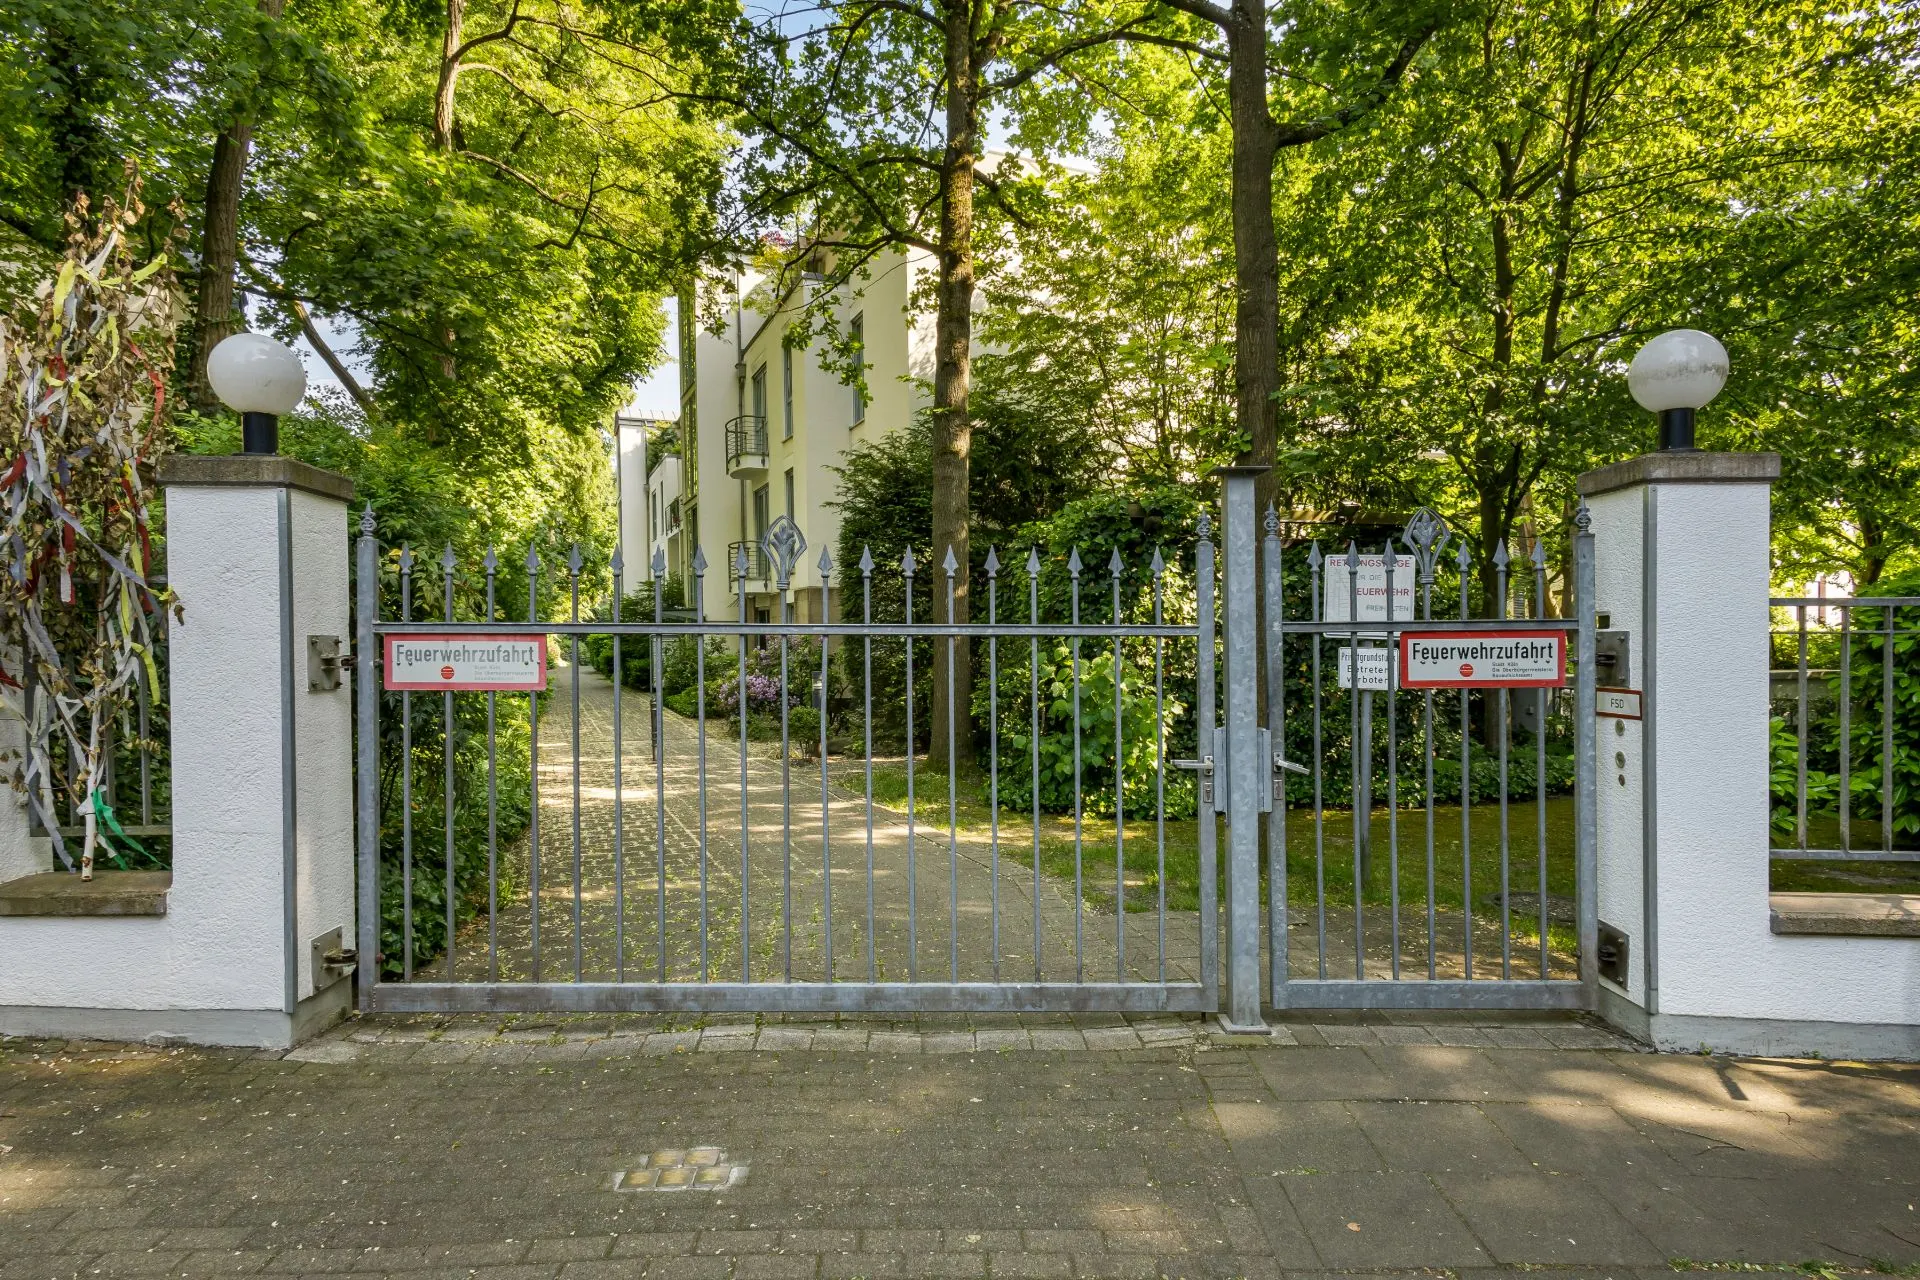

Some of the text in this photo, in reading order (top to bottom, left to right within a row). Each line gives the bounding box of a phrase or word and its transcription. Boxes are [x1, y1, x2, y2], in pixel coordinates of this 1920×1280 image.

[396, 644, 535, 663] Feuerwehrzufahrt
[1412, 642, 1554, 660] Feuerwehrzufahrt
[1610, 698, 1625, 709] FSD
